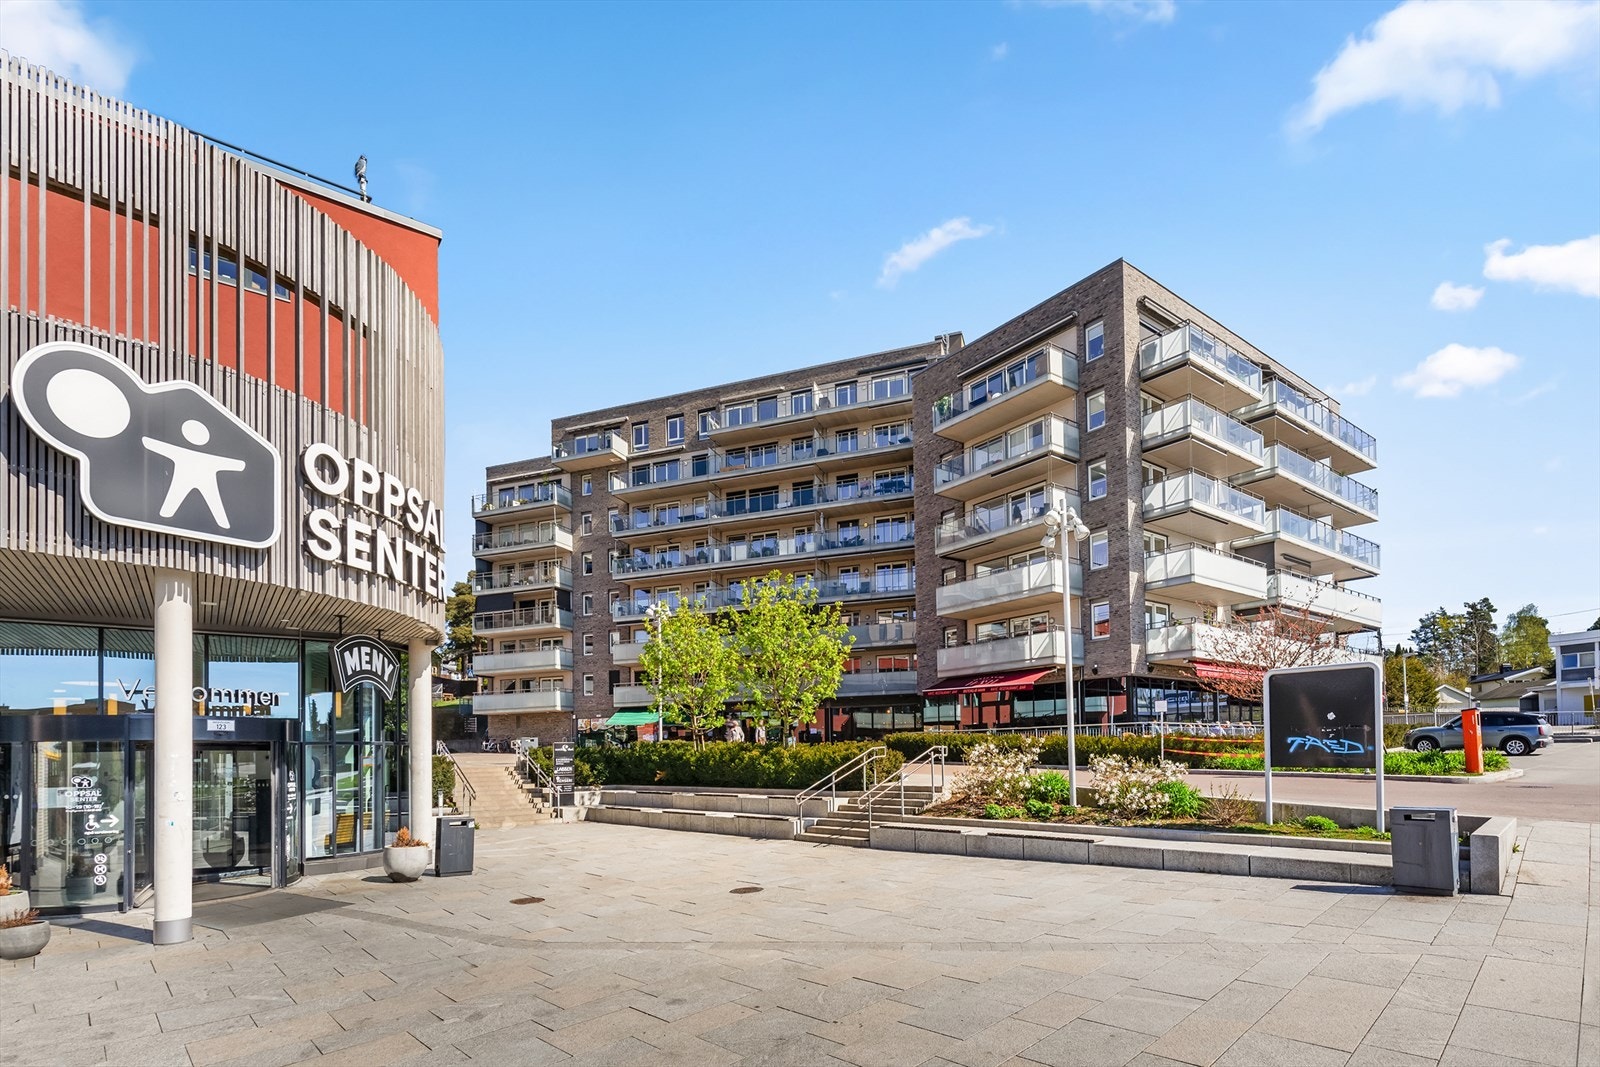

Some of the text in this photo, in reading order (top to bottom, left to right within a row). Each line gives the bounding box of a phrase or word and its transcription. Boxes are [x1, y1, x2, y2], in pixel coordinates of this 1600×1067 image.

[306, 508, 447, 604] SENTER
[343, 646, 394, 682] MENY
[117, 679, 280, 705] Veommen
